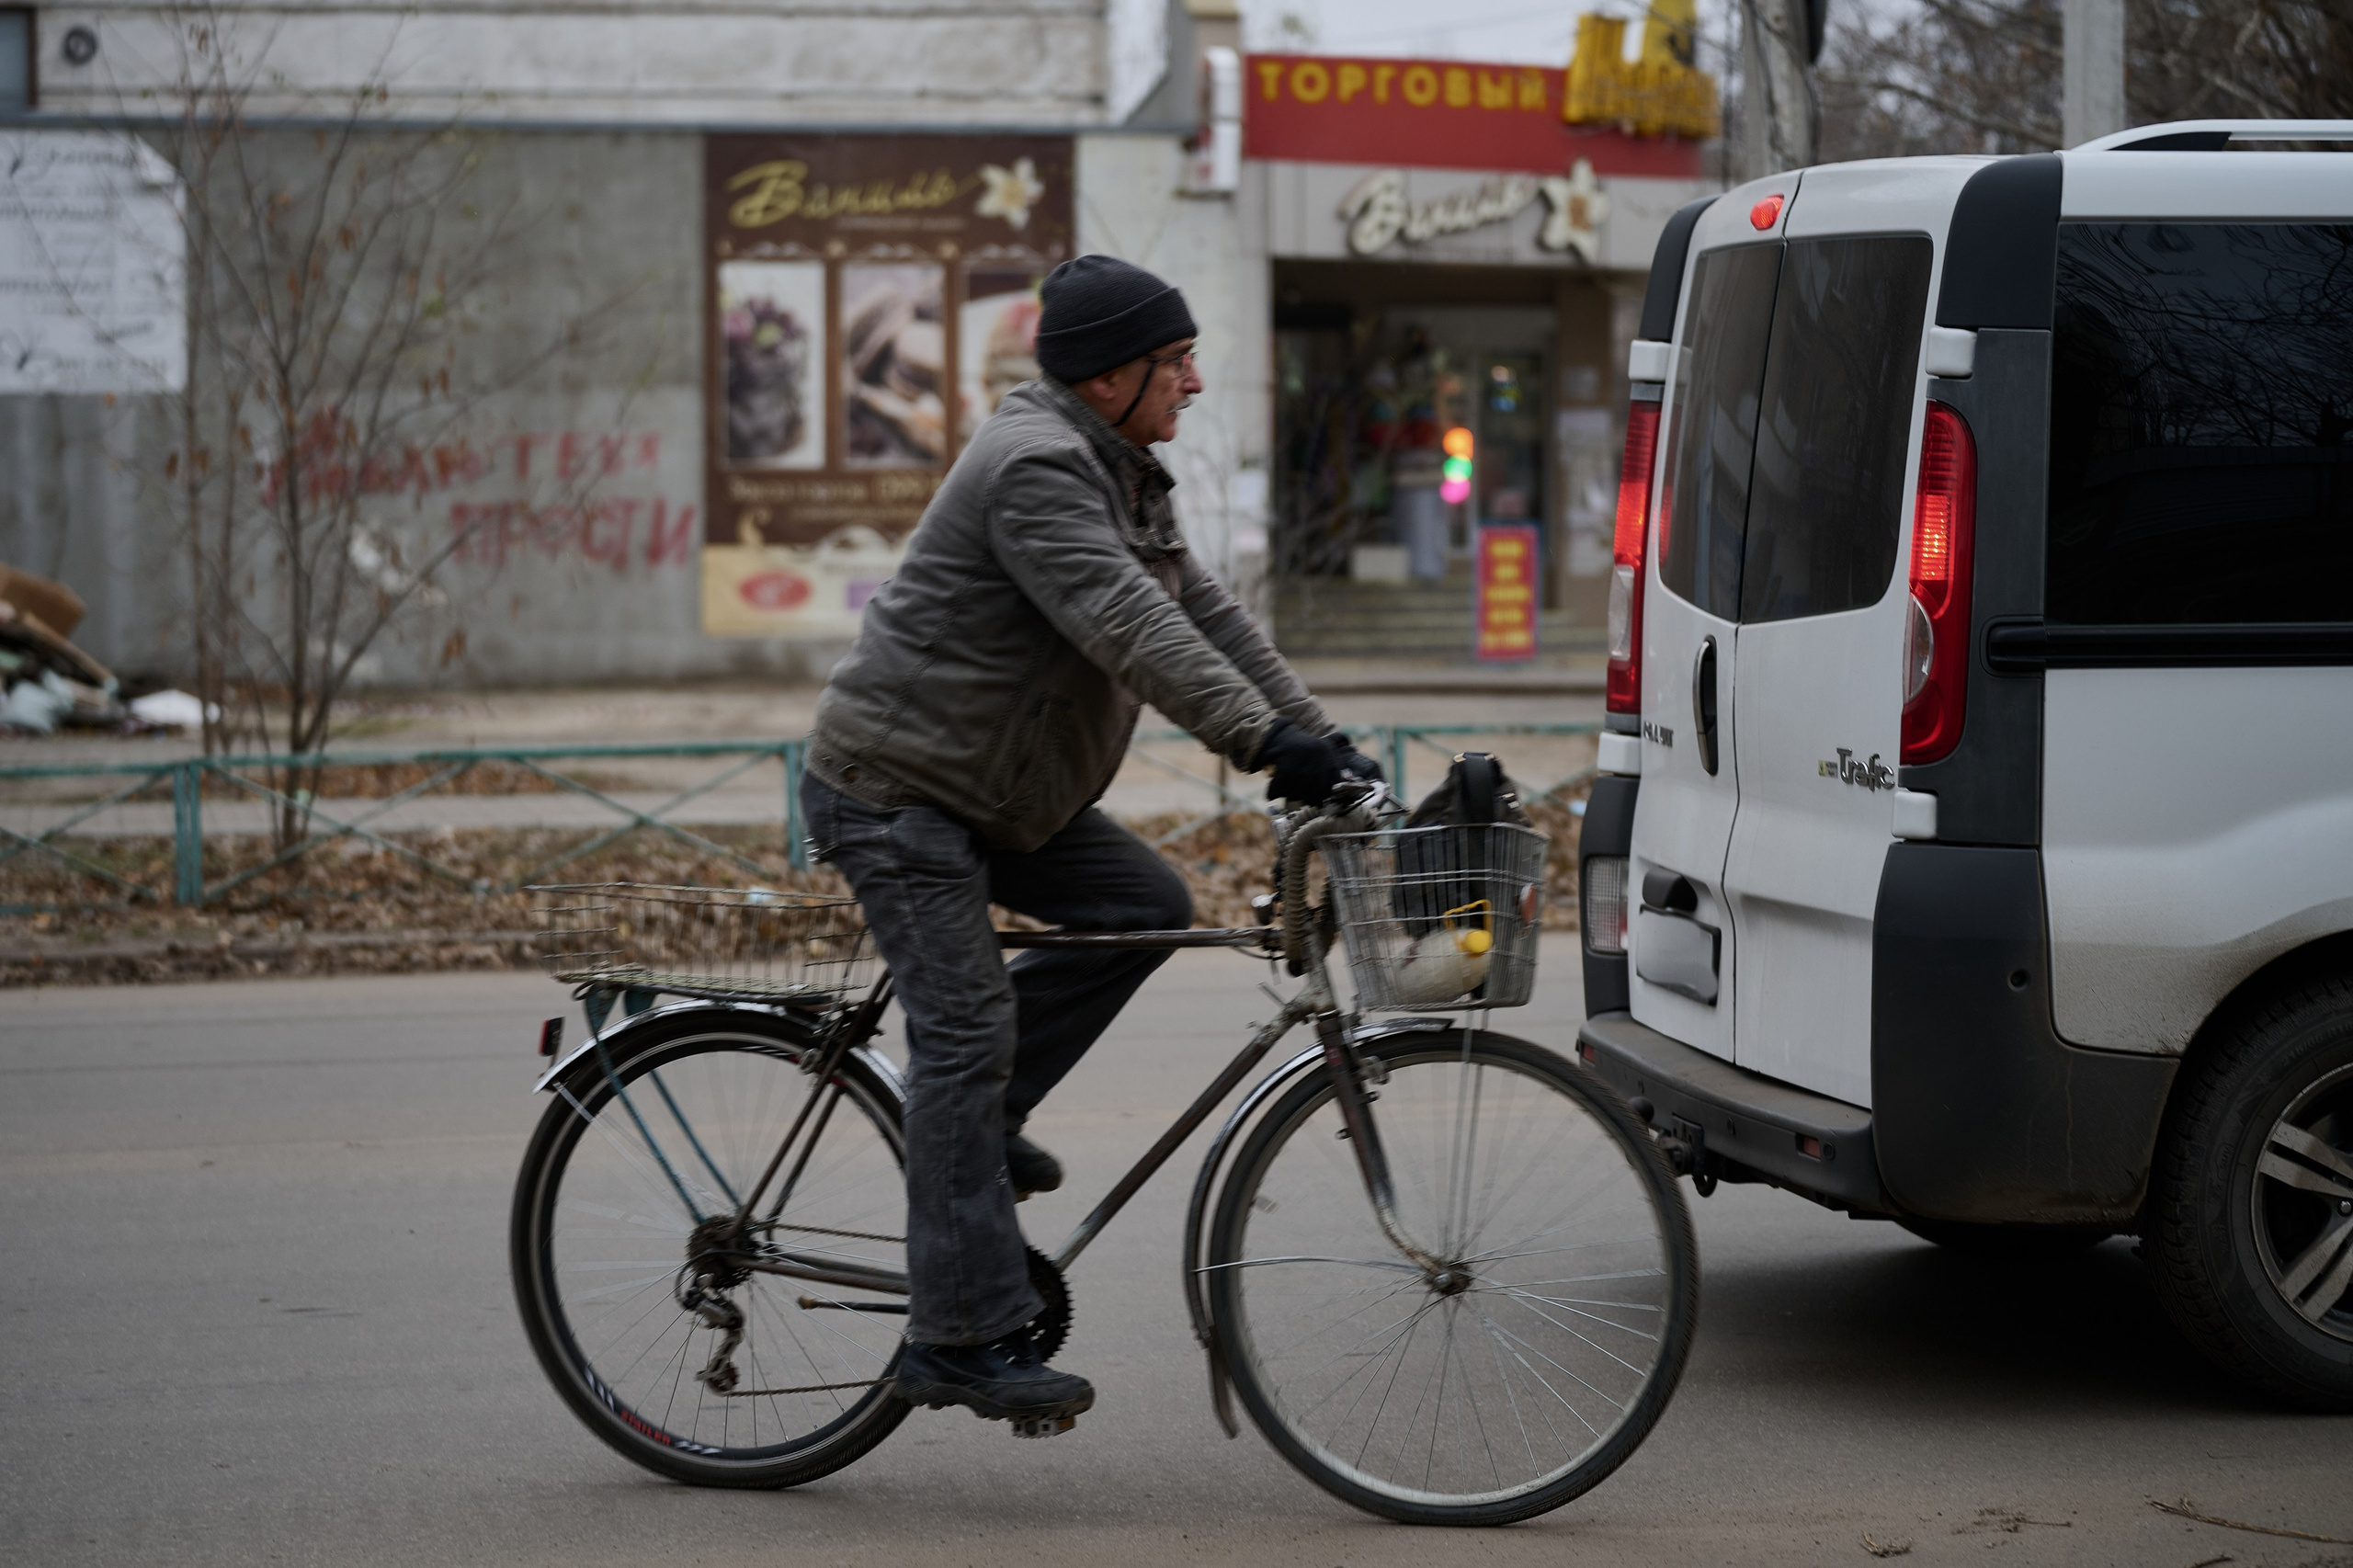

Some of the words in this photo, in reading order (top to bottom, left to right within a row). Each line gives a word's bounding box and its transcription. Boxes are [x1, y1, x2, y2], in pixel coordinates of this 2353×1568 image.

[1256, 60, 1547, 112] ТОРГОВЫЙ
[450, 494, 697, 574] ПРОСТИ
[1836, 746, 1895, 793] Trafic
